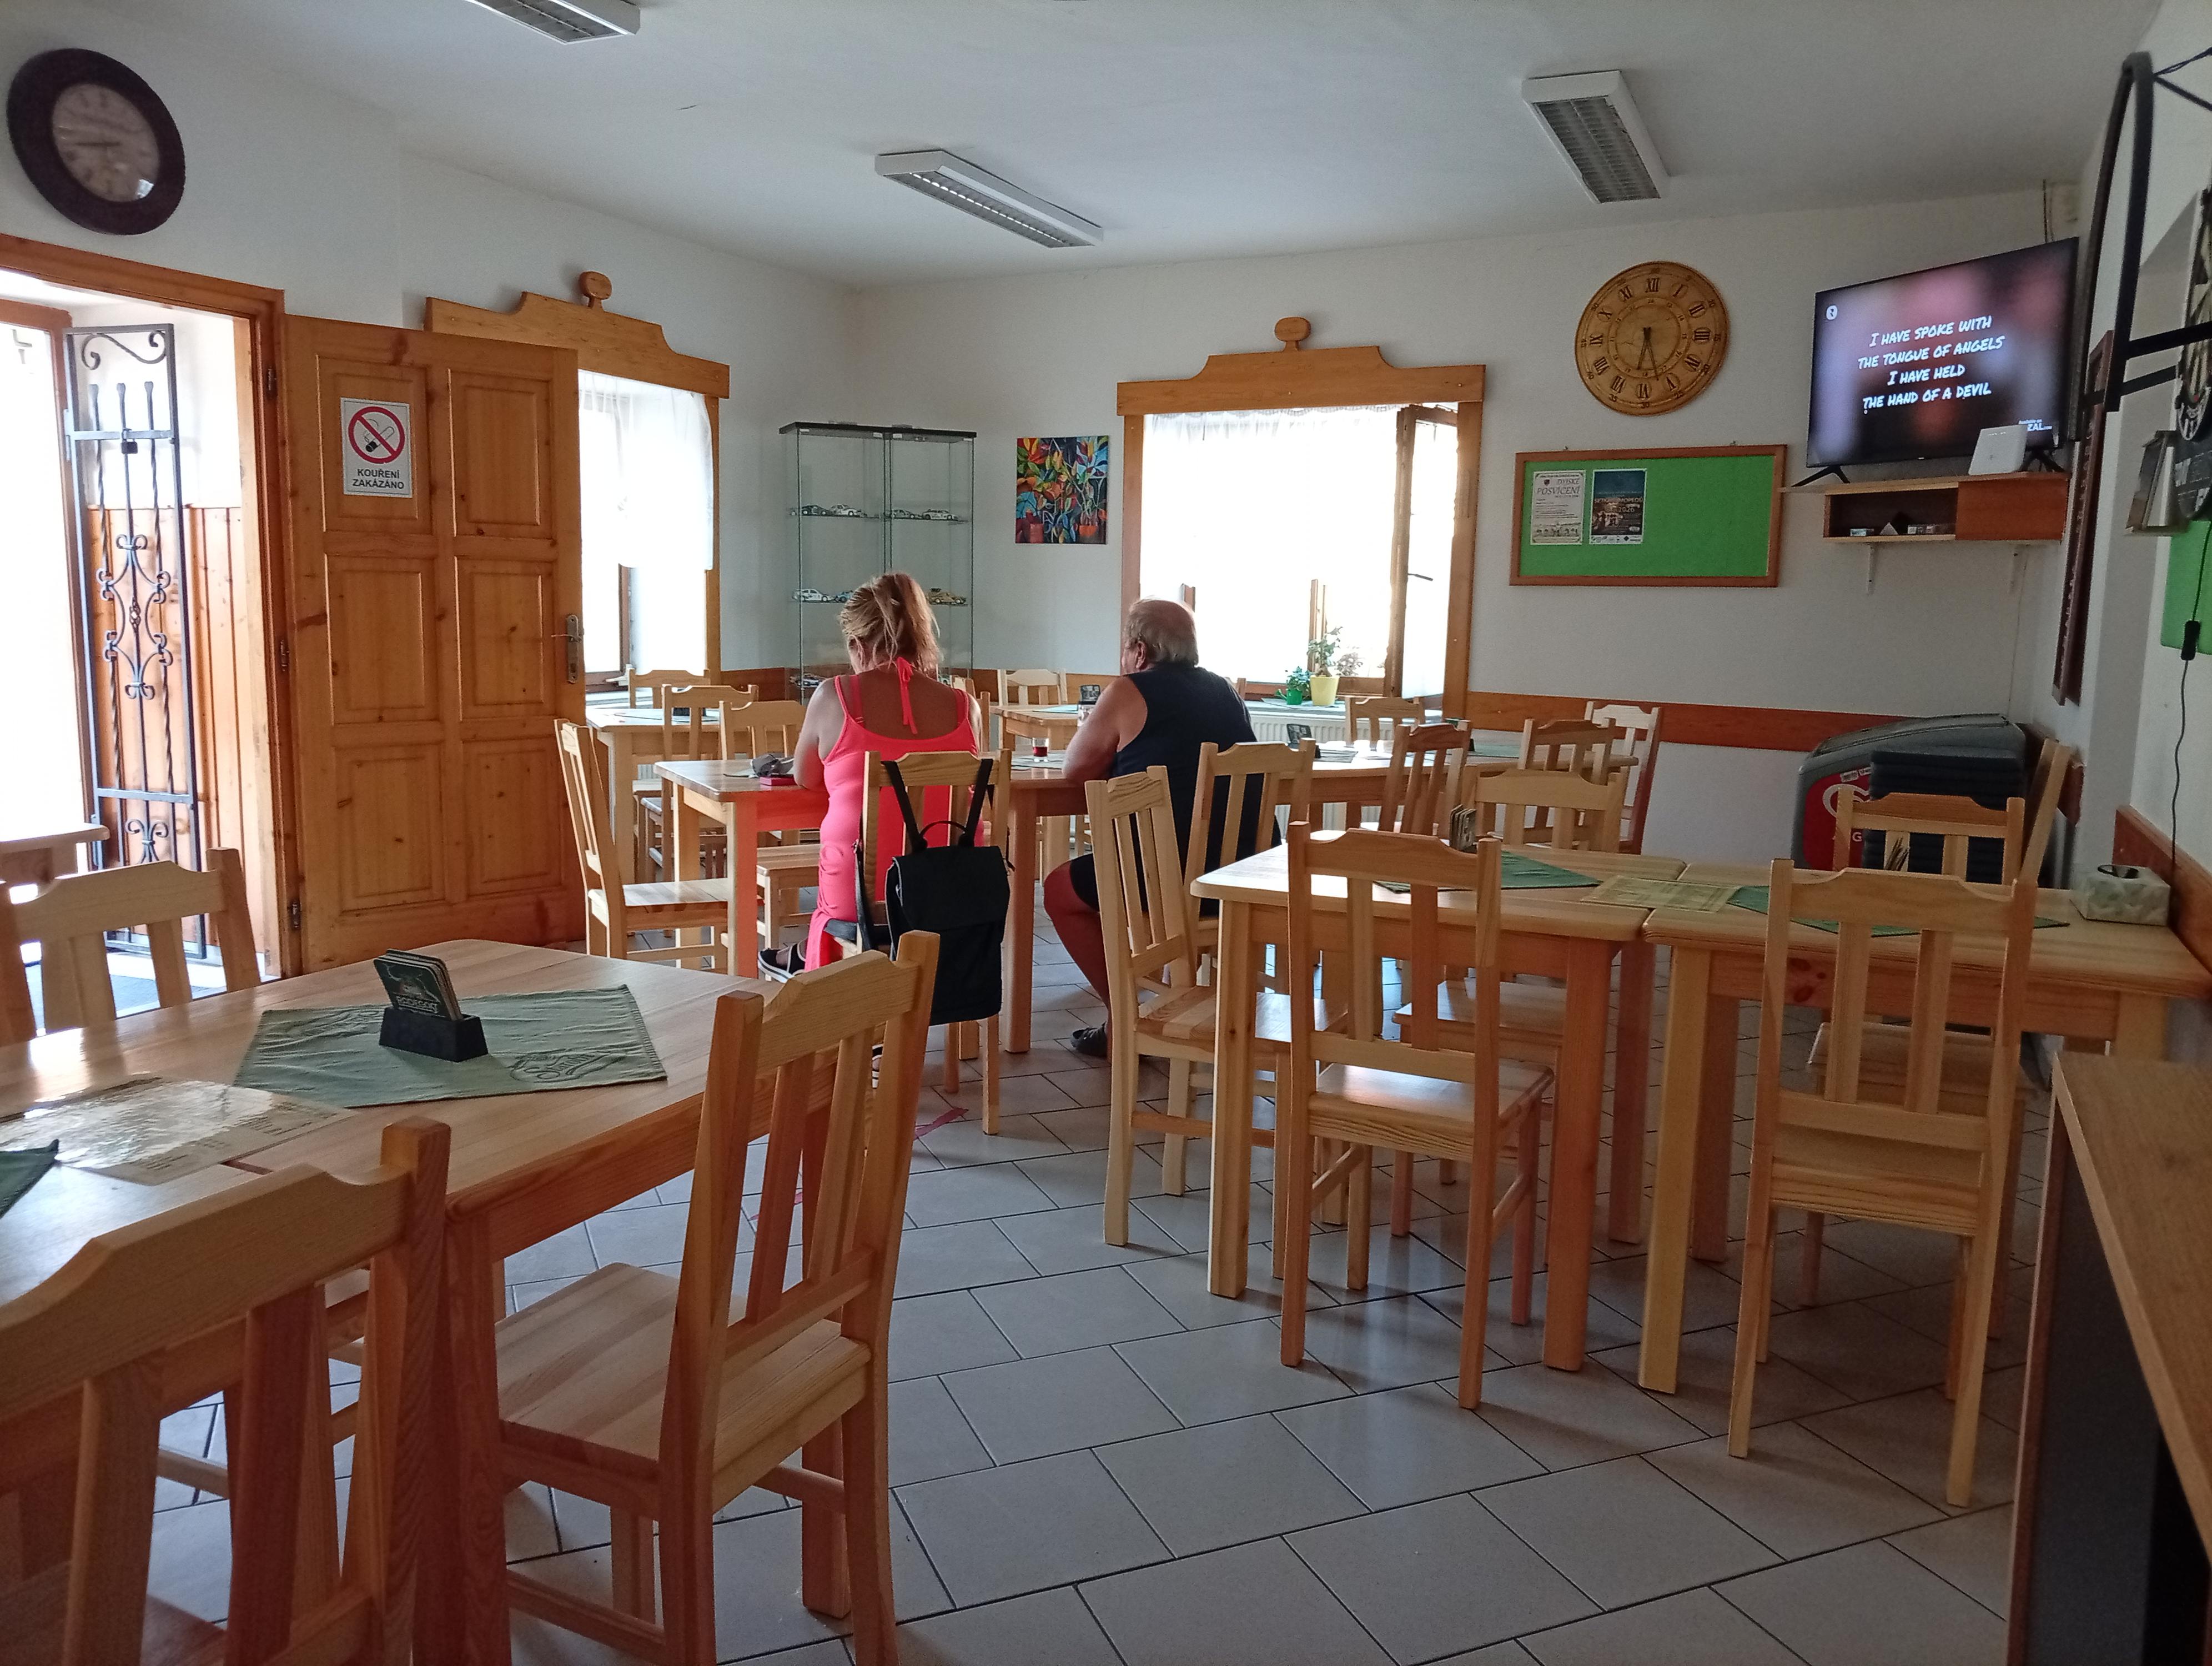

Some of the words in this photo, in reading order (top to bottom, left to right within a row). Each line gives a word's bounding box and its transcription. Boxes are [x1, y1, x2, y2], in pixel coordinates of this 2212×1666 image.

[1645, 278, 1660, 293] XII
[1672, 284, 1684, 298] I
[1619, 286, 1632, 302] XI
[1597, 307, 1612, 320] X
[1688, 304, 1705, 316] II
[1693, 330, 1710, 341] III
[1869, 333, 1879, 347] I
[1881, 329, 1911, 345] HAVE
[1914, 322, 1954, 340] SPOKE
[1959, 315, 1992, 333] WITH
[1590, 334, 1603, 345] IX
[1858, 355, 1878, 369] THE
[1883, 348, 1930, 366] TONGUE
[1933, 344, 1952, 358] OF
[1953, 336, 2005, 355] ANGELS
[1594, 357, 1610, 375] VIII
[1685, 355, 1701, 371] IV
[1887, 371, 1897, 386] I
[1899, 369, 1931, 384] HAVE
[1933, 364, 1965, 379] HELD
[1611, 375, 1626, 394] VII
[1638, 383, 1648, 399] VI
[1666, 376, 1677, 391] V
[1609, 394, 1618, 402] 35
[1863, 395, 1884, 409] THE
[1888, 392, 1918, 407] HAND
[1923, 389, 1940, 402] OF
[1942, 387, 1952, 400] A
[1956, 382, 1992, 398] DEVIL
[357, 468, 400, 478] KOUŘENÍ
[352, 478, 404, 489] ZAKÁZÁNO
